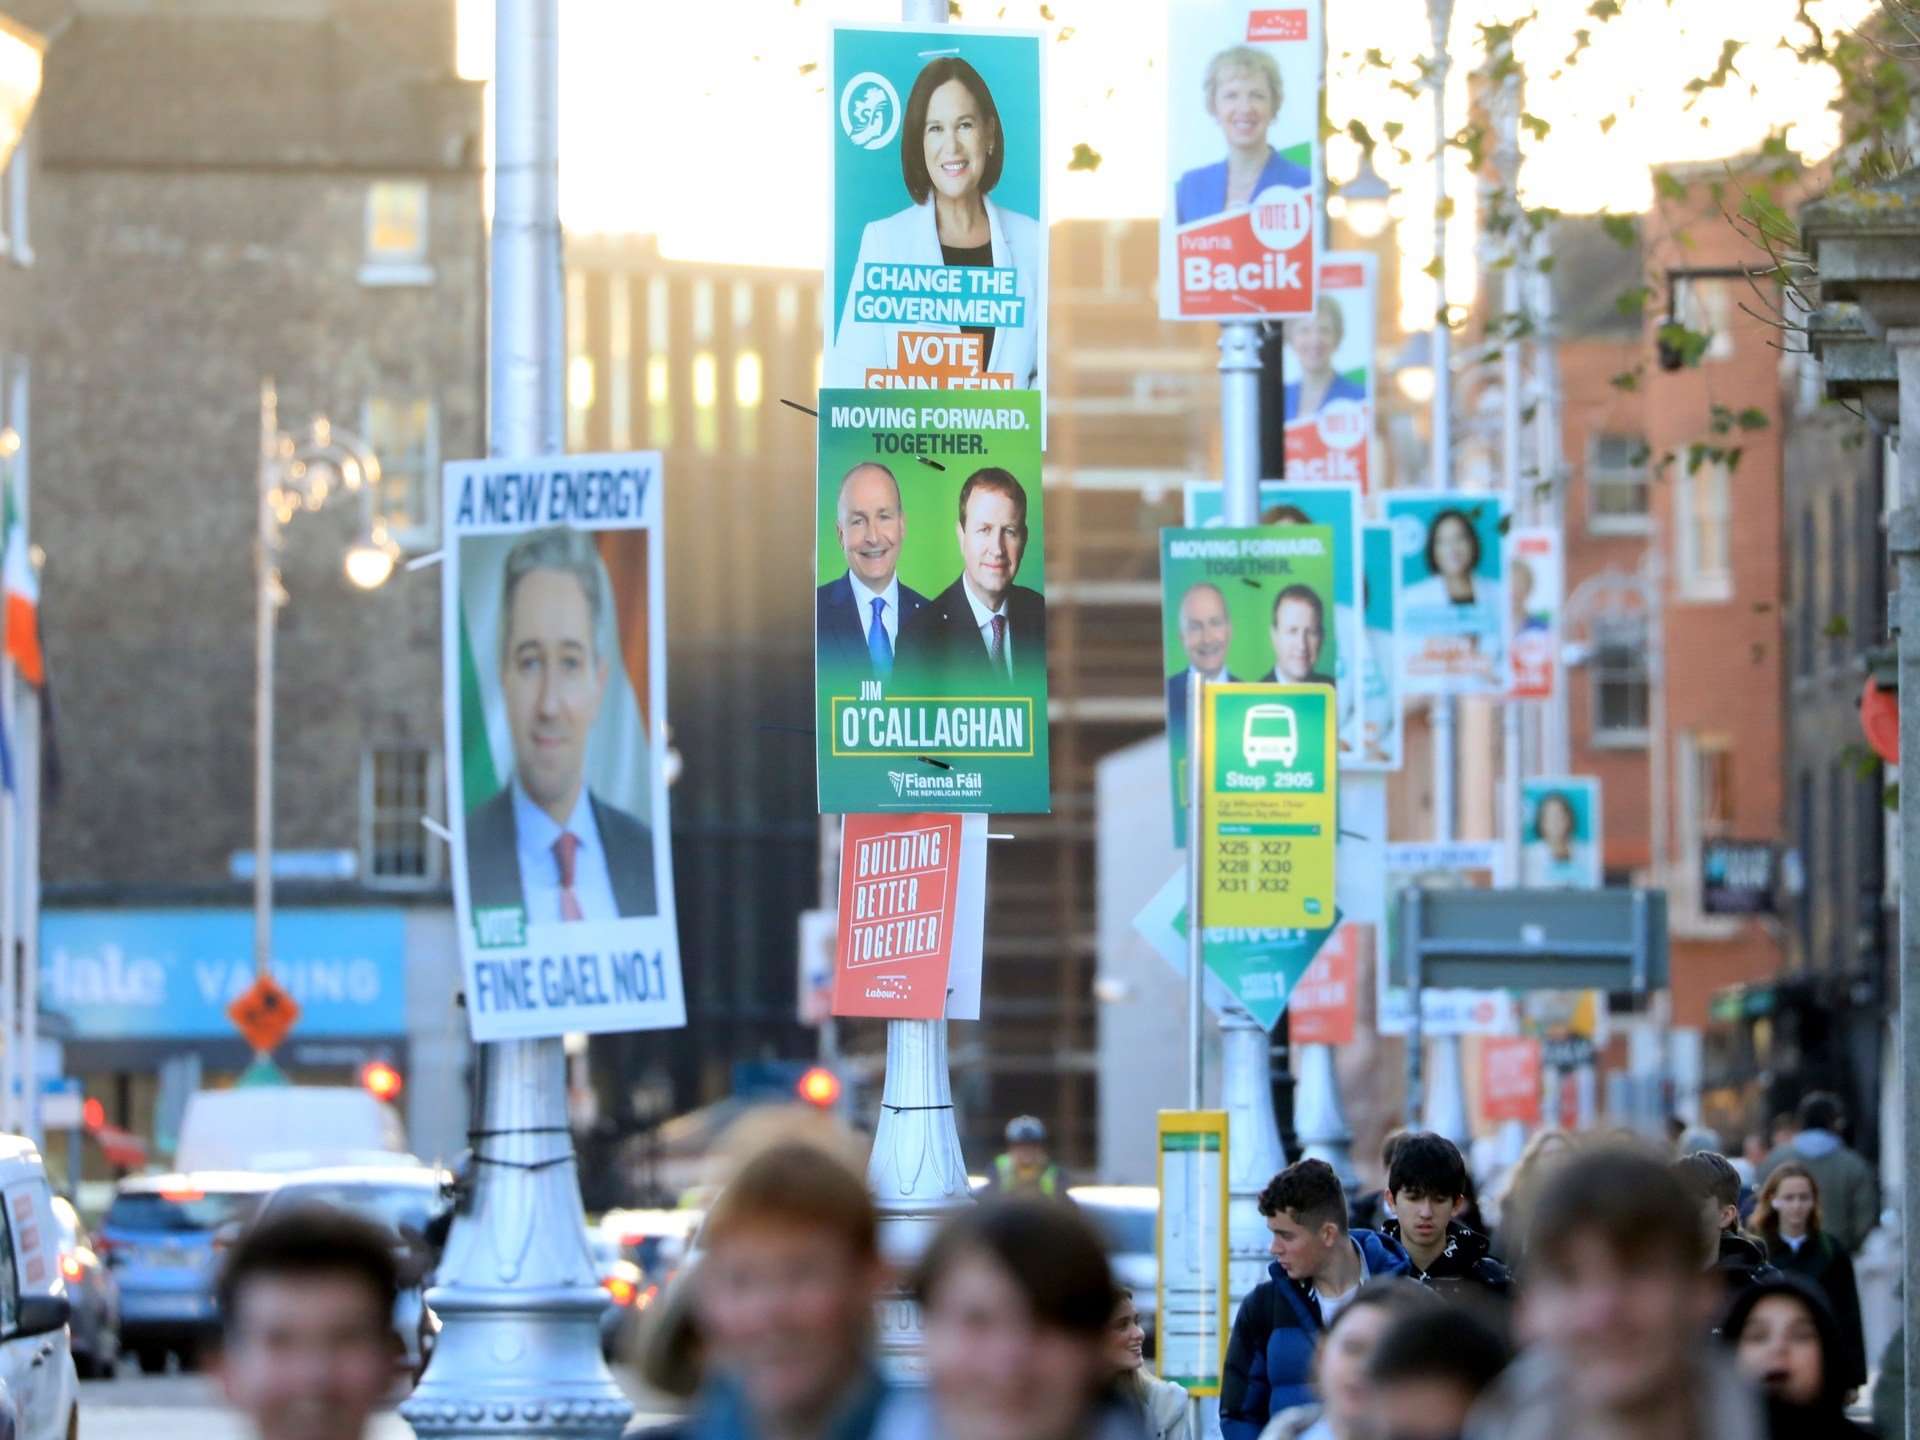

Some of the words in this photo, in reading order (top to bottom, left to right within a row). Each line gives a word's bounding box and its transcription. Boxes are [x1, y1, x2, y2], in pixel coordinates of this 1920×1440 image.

[1259, 203, 1287, 231] VOTE
[1292, 202, 1301, 231] 1
[1182, 234, 1233, 250] Ivana
[866, 266, 962, 293] CHANGE
[967, 270, 1014, 295] THE
[1184, 252, 1302, 292] Bacik
[857, 295, 1022, 324] GOVERNMENT
[902, 335, 979, 366] VOTE
[831, 406, 917, 429] MOVING
[921, 407, 1030, 430] FORWARD.
[872, 432, 989, 455] TOGETHER.
[456, 473, 474, 524] A
[480, 470, 546, 523] NEW
[548, 466, 651, 520] ENERGY
[1170, 540, 1238, 559] MOVING
[1240, 538, 1326, 558] FORWARD.
[1204, 559, 1293, 575] TOGETHER.
[860, 680, 882, 701] JIM
[842, 707, 1023, 747] O’CALLAGHAN
[905, 772, 953, 788] Fianna
[956, 772, 982, 788] Fáil
[1226, 771, 1266, 790] Stop
[1273, 771, 1314, 788] 2905
[859, 832, 941, 878] BUILDING
[1218, 841, 1249, 855] X25
[1260, 841, 1292, 855] X27
[1217, 859, 1249, 873] X28
[1260, 859, 1292, 873] X30
[1217, 878, 1248, 892] X31
[1258, 878, 1290, 892] X32
[856, 878, 918, 919] BETTER
[479, 909, 521, 943] VOTE
[854, 916, 937, 962] TOGETHER
[475, 958, 537, 1012] FINE
[540, 954, 609, 1008] GAEL
[866, 987, 897, 999] Labour
